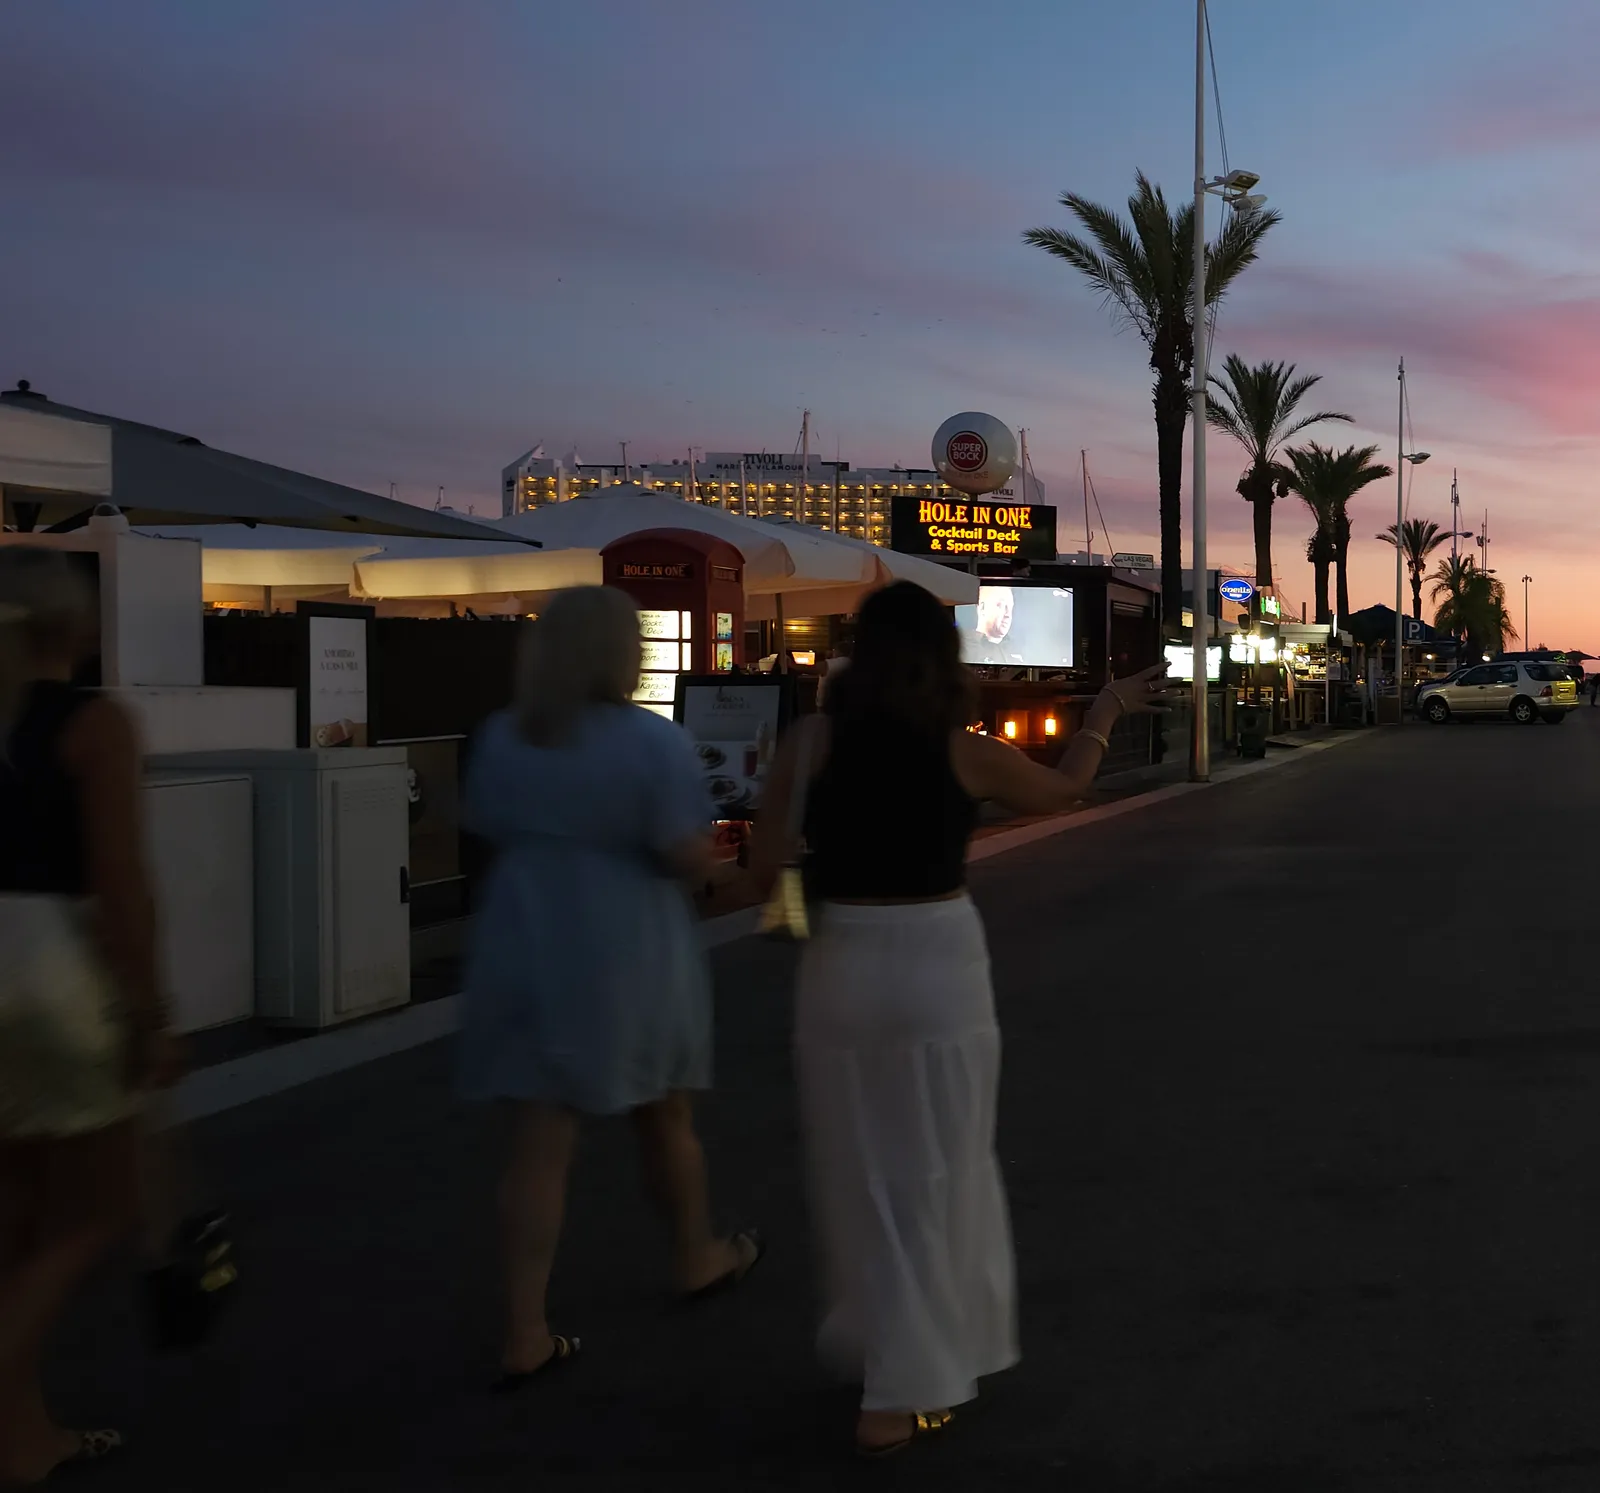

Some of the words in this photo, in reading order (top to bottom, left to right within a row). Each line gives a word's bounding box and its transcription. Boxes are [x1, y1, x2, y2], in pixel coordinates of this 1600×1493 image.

[952, 442, 982, 453] SUPER
[743, 453, 783, 465] TIVOLI
[953, 451, 980, 461] BOCK
[716, 463, 752, 471] MARIA
[919, 500, 968, 524] HOLE
[973, 506, 991, 525] IN
[995, 507, 1032, 529] ONE
[928, 525, 983, 540] Cocktail
[986, 528, 1021, 542] Deck
[930, 540, 942, 550] &
[946, 540, 989, 554] Sports
[993, 541, 1019, 554] Bar
[623, 564, 650, 576] HOLE
[652, 565, 663, 576] IN
[664, 564, 686, 577] ONE
[1408, 621, 1421, 639] P
